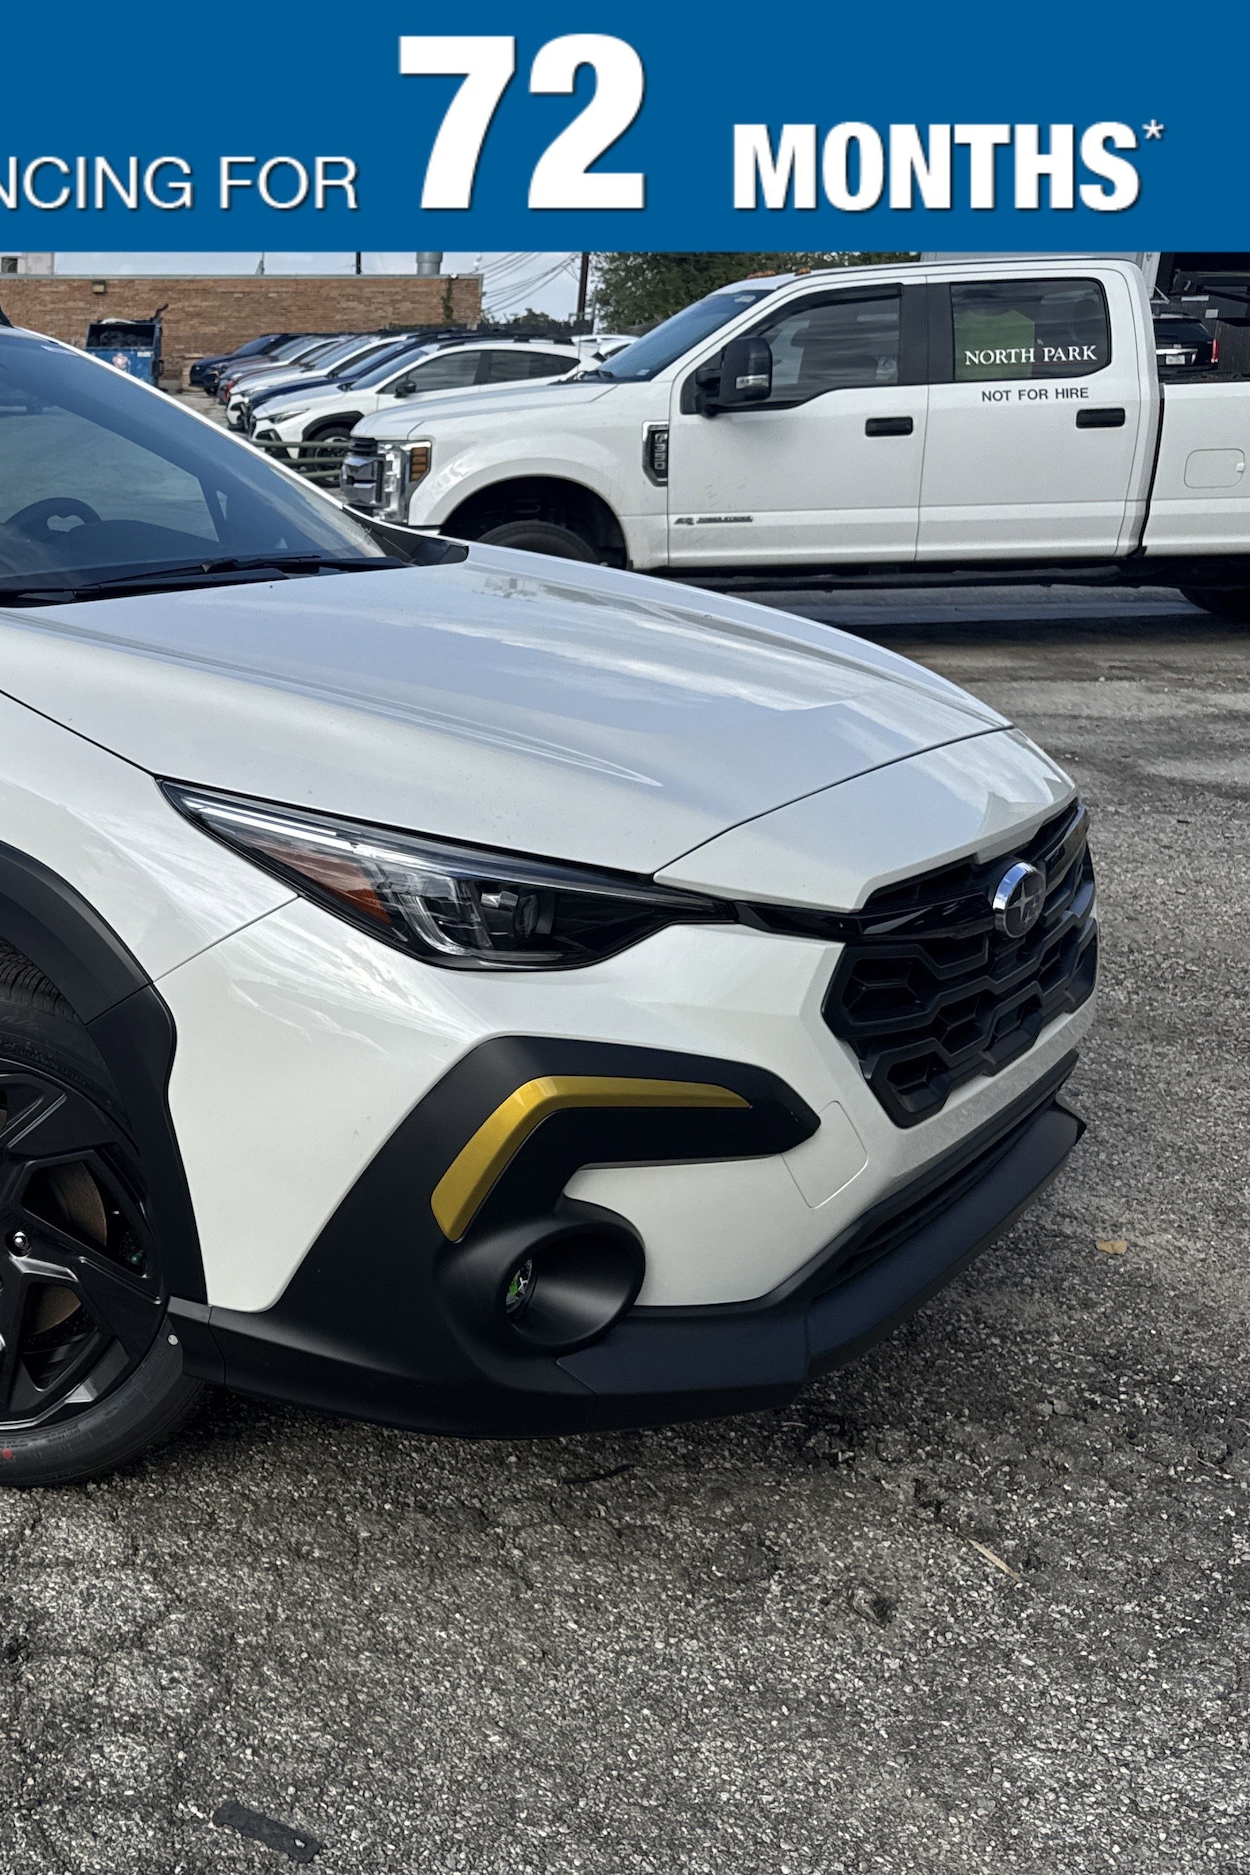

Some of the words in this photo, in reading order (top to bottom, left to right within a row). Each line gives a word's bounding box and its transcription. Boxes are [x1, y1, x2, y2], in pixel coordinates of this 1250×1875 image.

[964, 347, 1035, 366] NORTH
[1042, 344, 1098, 362] PARK
[981, 389, 1012, 402] NOT
[1018, 388, 1049, 401] FOR
[1055, 387, 1089, 400] HIRE
